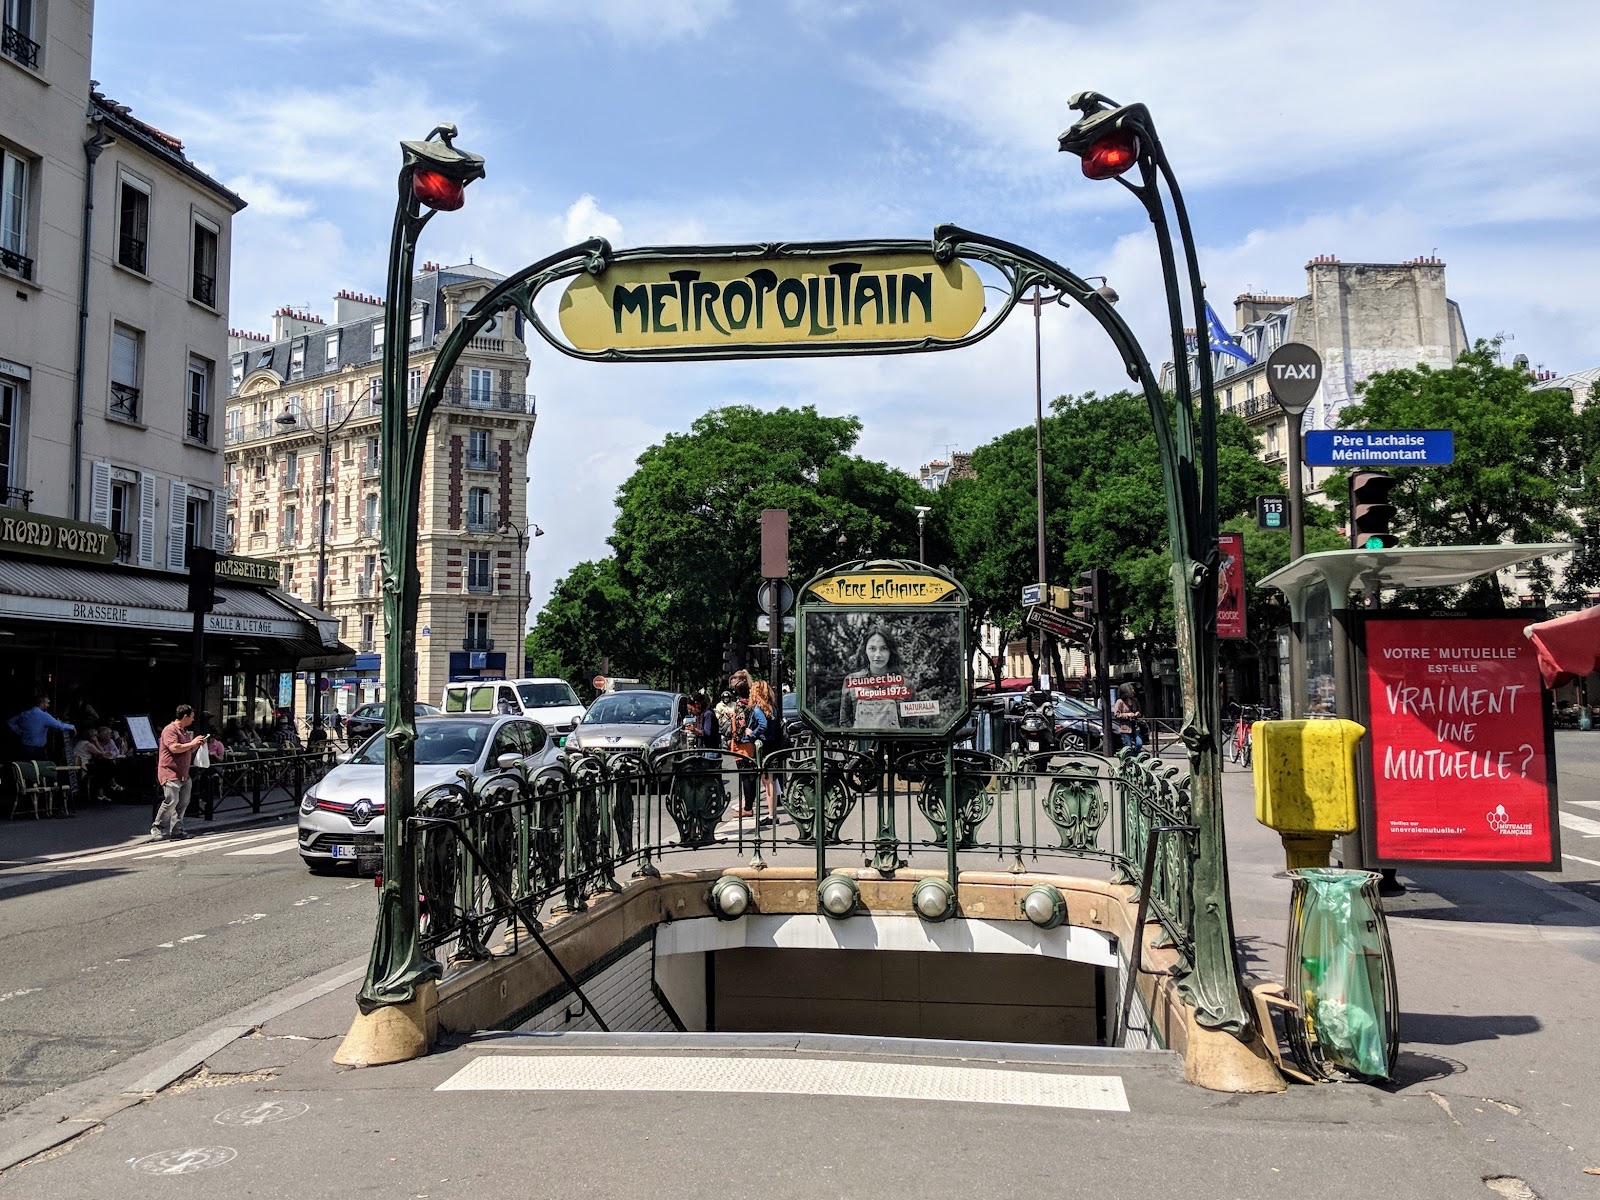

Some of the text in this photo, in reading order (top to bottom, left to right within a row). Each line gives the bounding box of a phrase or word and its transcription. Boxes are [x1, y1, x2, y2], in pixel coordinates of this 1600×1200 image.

[612, 262, 933, 336] METROPOLITAIN
[1273, 364, 1316, 379] TAXI
[1333, 434, 1425, 446] Père Lachaise
[1332, 448, 1427, 461] Ménilmontant
[1263, 503, 1283, 513] 113
[2, 517, 109, 555] ROND POINT
[215, 560, 266, 579] BRASSERIE
[73, 603, 128, 621] BRASSERIE
[209, 617, 234, 631] SALLE
[243, 620, 273, 633] L'ETAGE
[1383, 647, 1431, 659] VOTRE
[1428, 664, 1478, 673] EST-ELLE
[847, 673, 902, 687] Jeune et bio
[860, 686, 910, 698] depuis 1973.
[904, 703, 936, 711] NATURALIA
[1437, 719, 1478, 742] UNE
